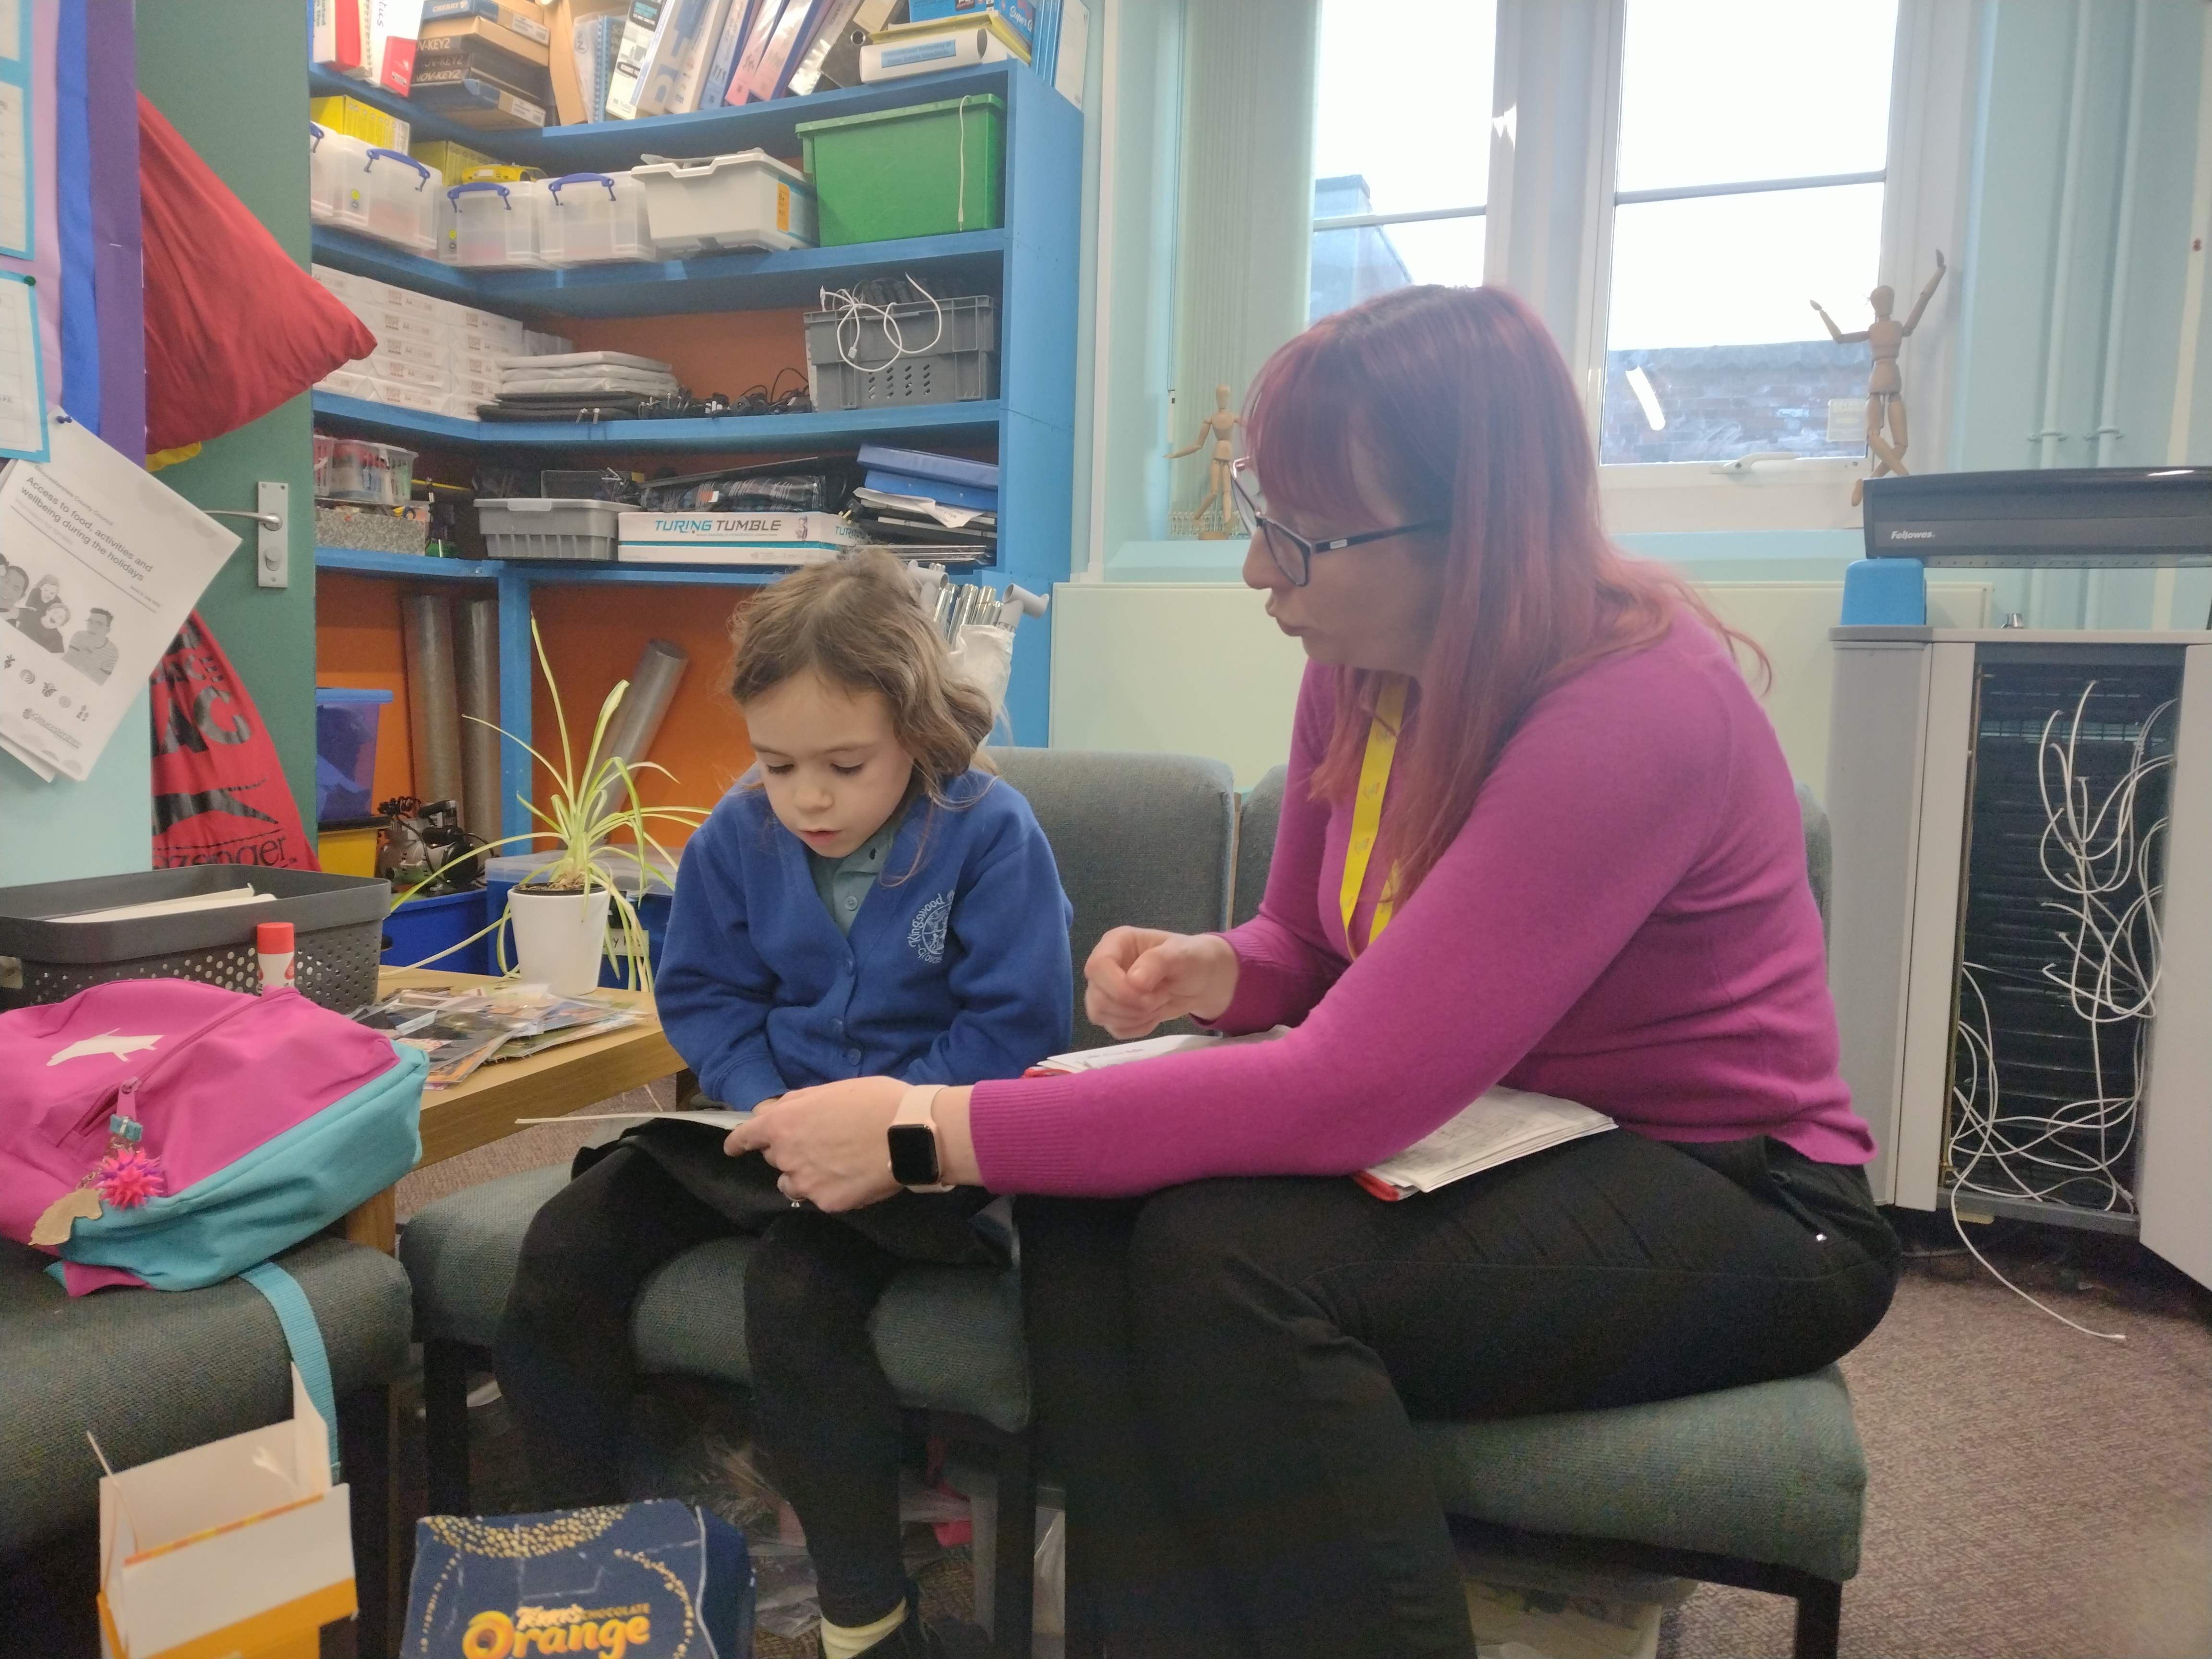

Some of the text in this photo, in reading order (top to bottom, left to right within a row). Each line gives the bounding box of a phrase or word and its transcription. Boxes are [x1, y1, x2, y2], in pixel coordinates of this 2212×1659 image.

[433, 2, 459, 13] CHERRY
[1010, 5, 1027, 26] Super
[35, 465, 114, 527] Gloucestershire County Council
[21, 487, 144, 581] wellbeing during the holidays
[26, 477, 153, 573] Access to food, activities and
[655, 520, 781, 533] TURING TUMBLE
[1891, 530, 1933, 540] Fellowes
[907, 892, 945, 948] Kingswood
[462, 1610, 651, 1659] Orange
